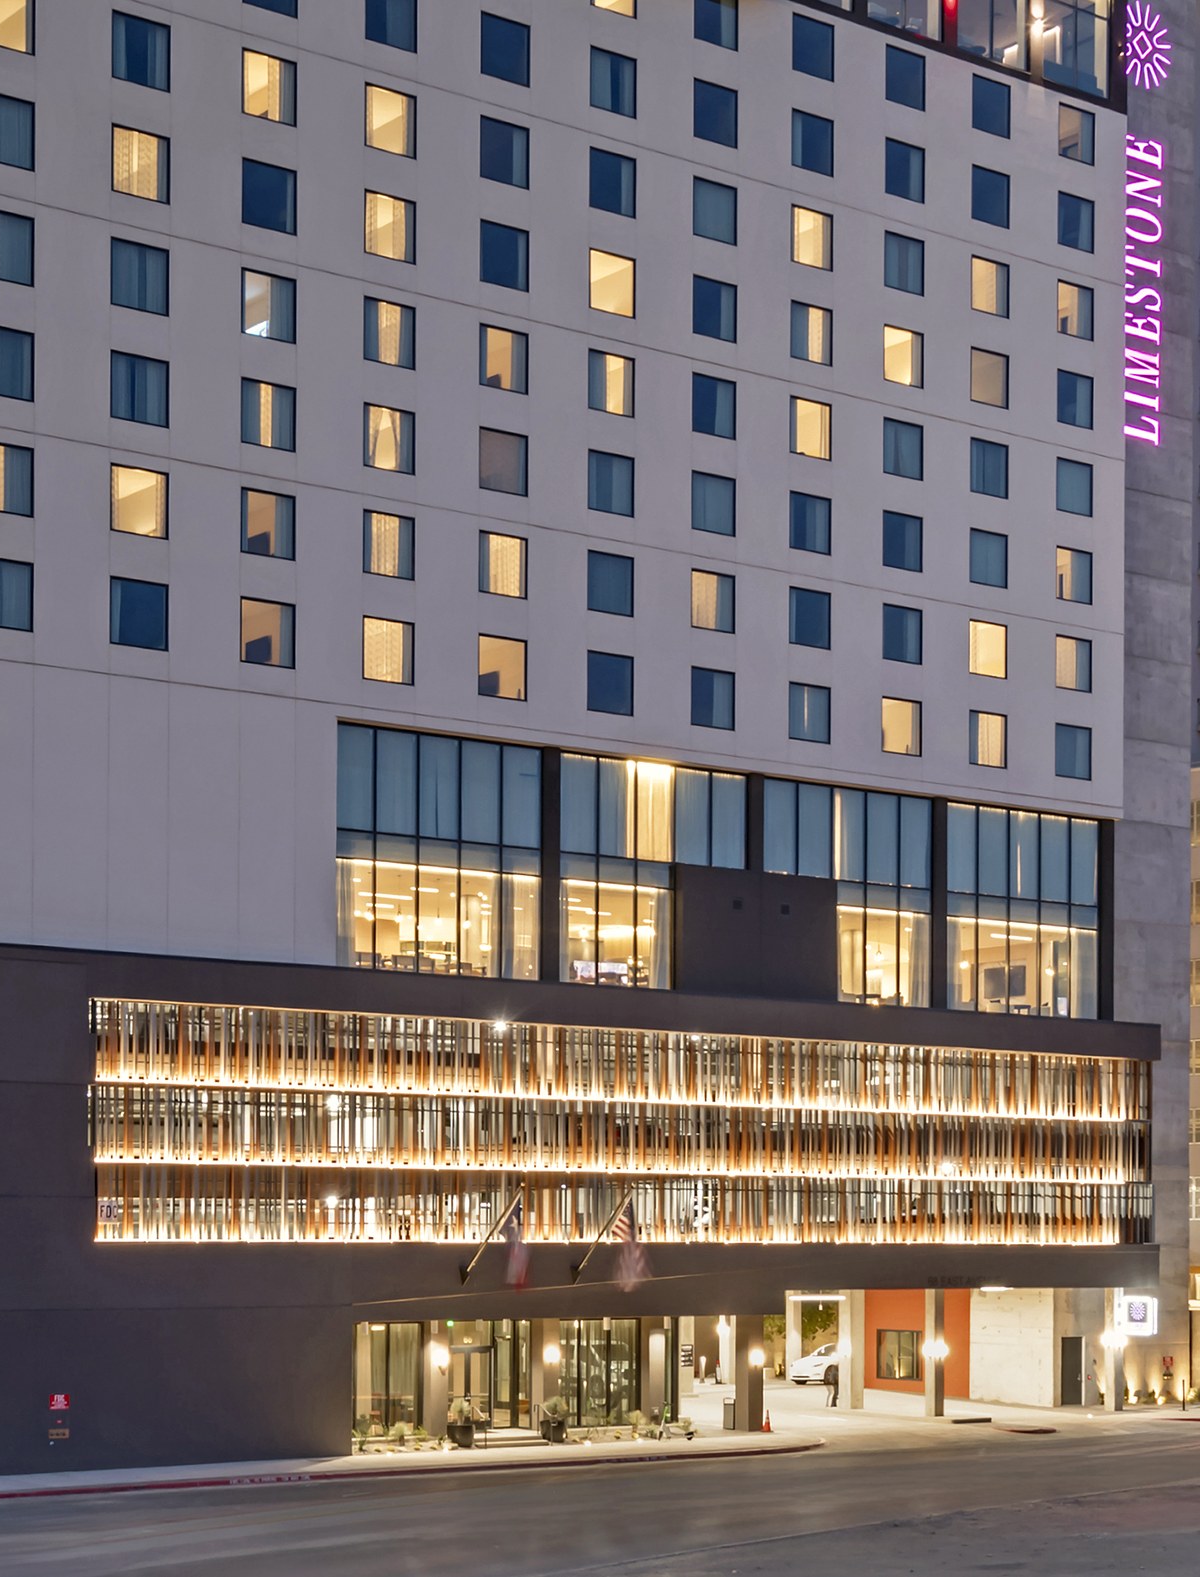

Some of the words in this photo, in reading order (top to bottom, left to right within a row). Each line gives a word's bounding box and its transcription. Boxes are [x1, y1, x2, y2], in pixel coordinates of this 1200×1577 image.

[1123, 134, 1163, 445] LIMESTONE
[100, 1205, 117, 1218] FDC
[940, 1275, 964, 1287] EAST
